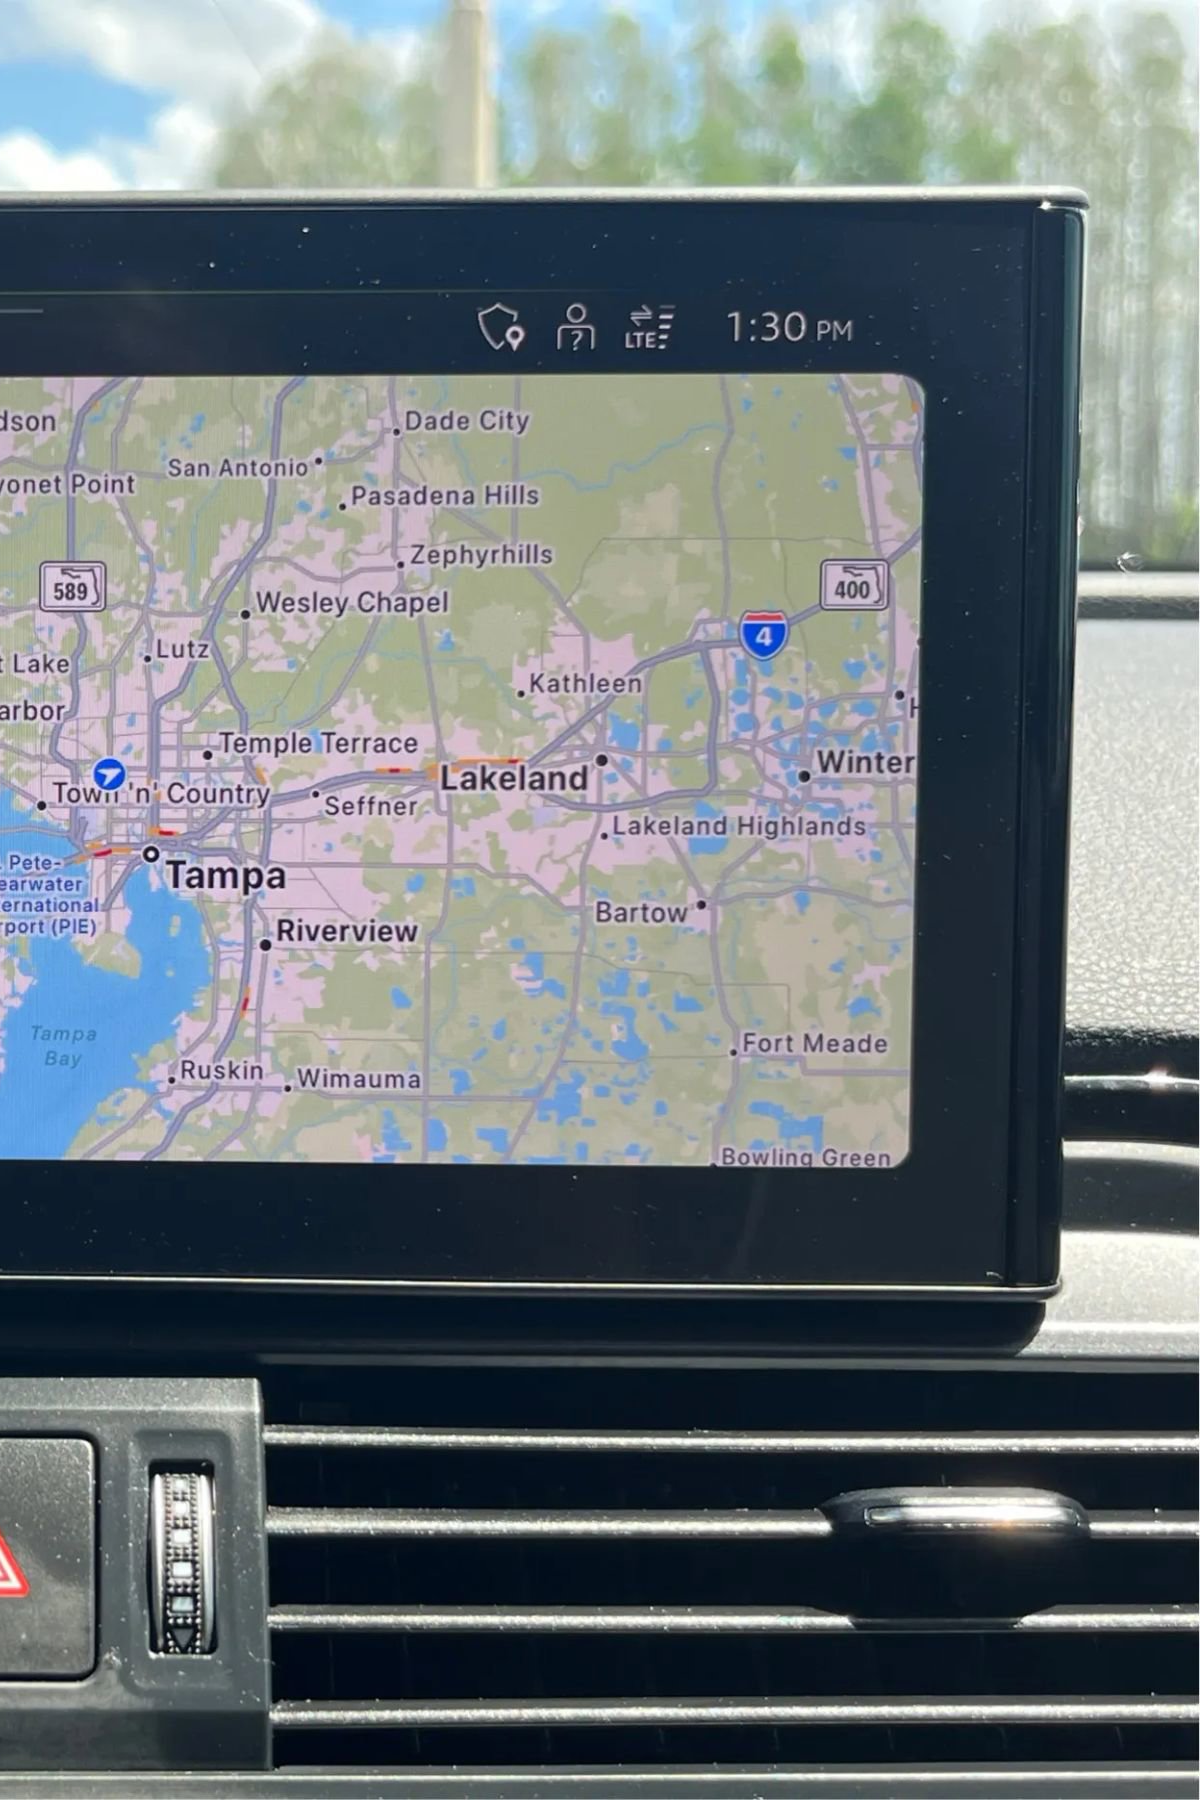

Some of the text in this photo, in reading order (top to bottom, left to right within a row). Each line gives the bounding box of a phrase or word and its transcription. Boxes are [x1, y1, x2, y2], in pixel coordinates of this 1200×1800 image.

[728, 312, 853, 341] 1:30 PM
[625, 333, 655, 348] LTE
[405, 411, 529, 434] Dade City
[168, 459, 308, 477] San Antonio
[72, 474, 135, 494] Point
[352, 485, 539, 505] Pasadena Hills
[411, 545, 552, 568] Zephyrhills
[53, 583, 88, 601] 589
[835, 581, 870, 599] 400
[257, 591, 448, 616] Wesley Chapel
[755, 627, 772, 646] 4
[157, 639, 209, 658] Lutz
[13, 655, 69, 673] Lake
[530, 673, 641, 693] Kathleen
[219, 732, 418, 758] Temple Terrace
[817, 750, 915, 774] Winter
[441, 764, 588, 790] Lakeland
[167, 782, 270, 807] Country
[325, 797, 417, 816] Seffner
[613, 816, 866, 840] Lakeland Highlands
[9, 854, 62, 870] Pete-
[166, 860, 286, 895] Tampa
[596, 902, 687, 923] Bartow
[51, 918, 96, 937] (PIE)
[276, 919, 418, 943] Riverview
[31, 1026, 97, 1047] Tampa
[743, 1033, 887, 1053] Fort Meade
[45, 1051, 83, 1069] Bay
[181, 1061, 264, 1080] Ruskin
[297, 1069, 421, 1089] Wimauma
[722, 1148, 890, 1167] Bowling Green
